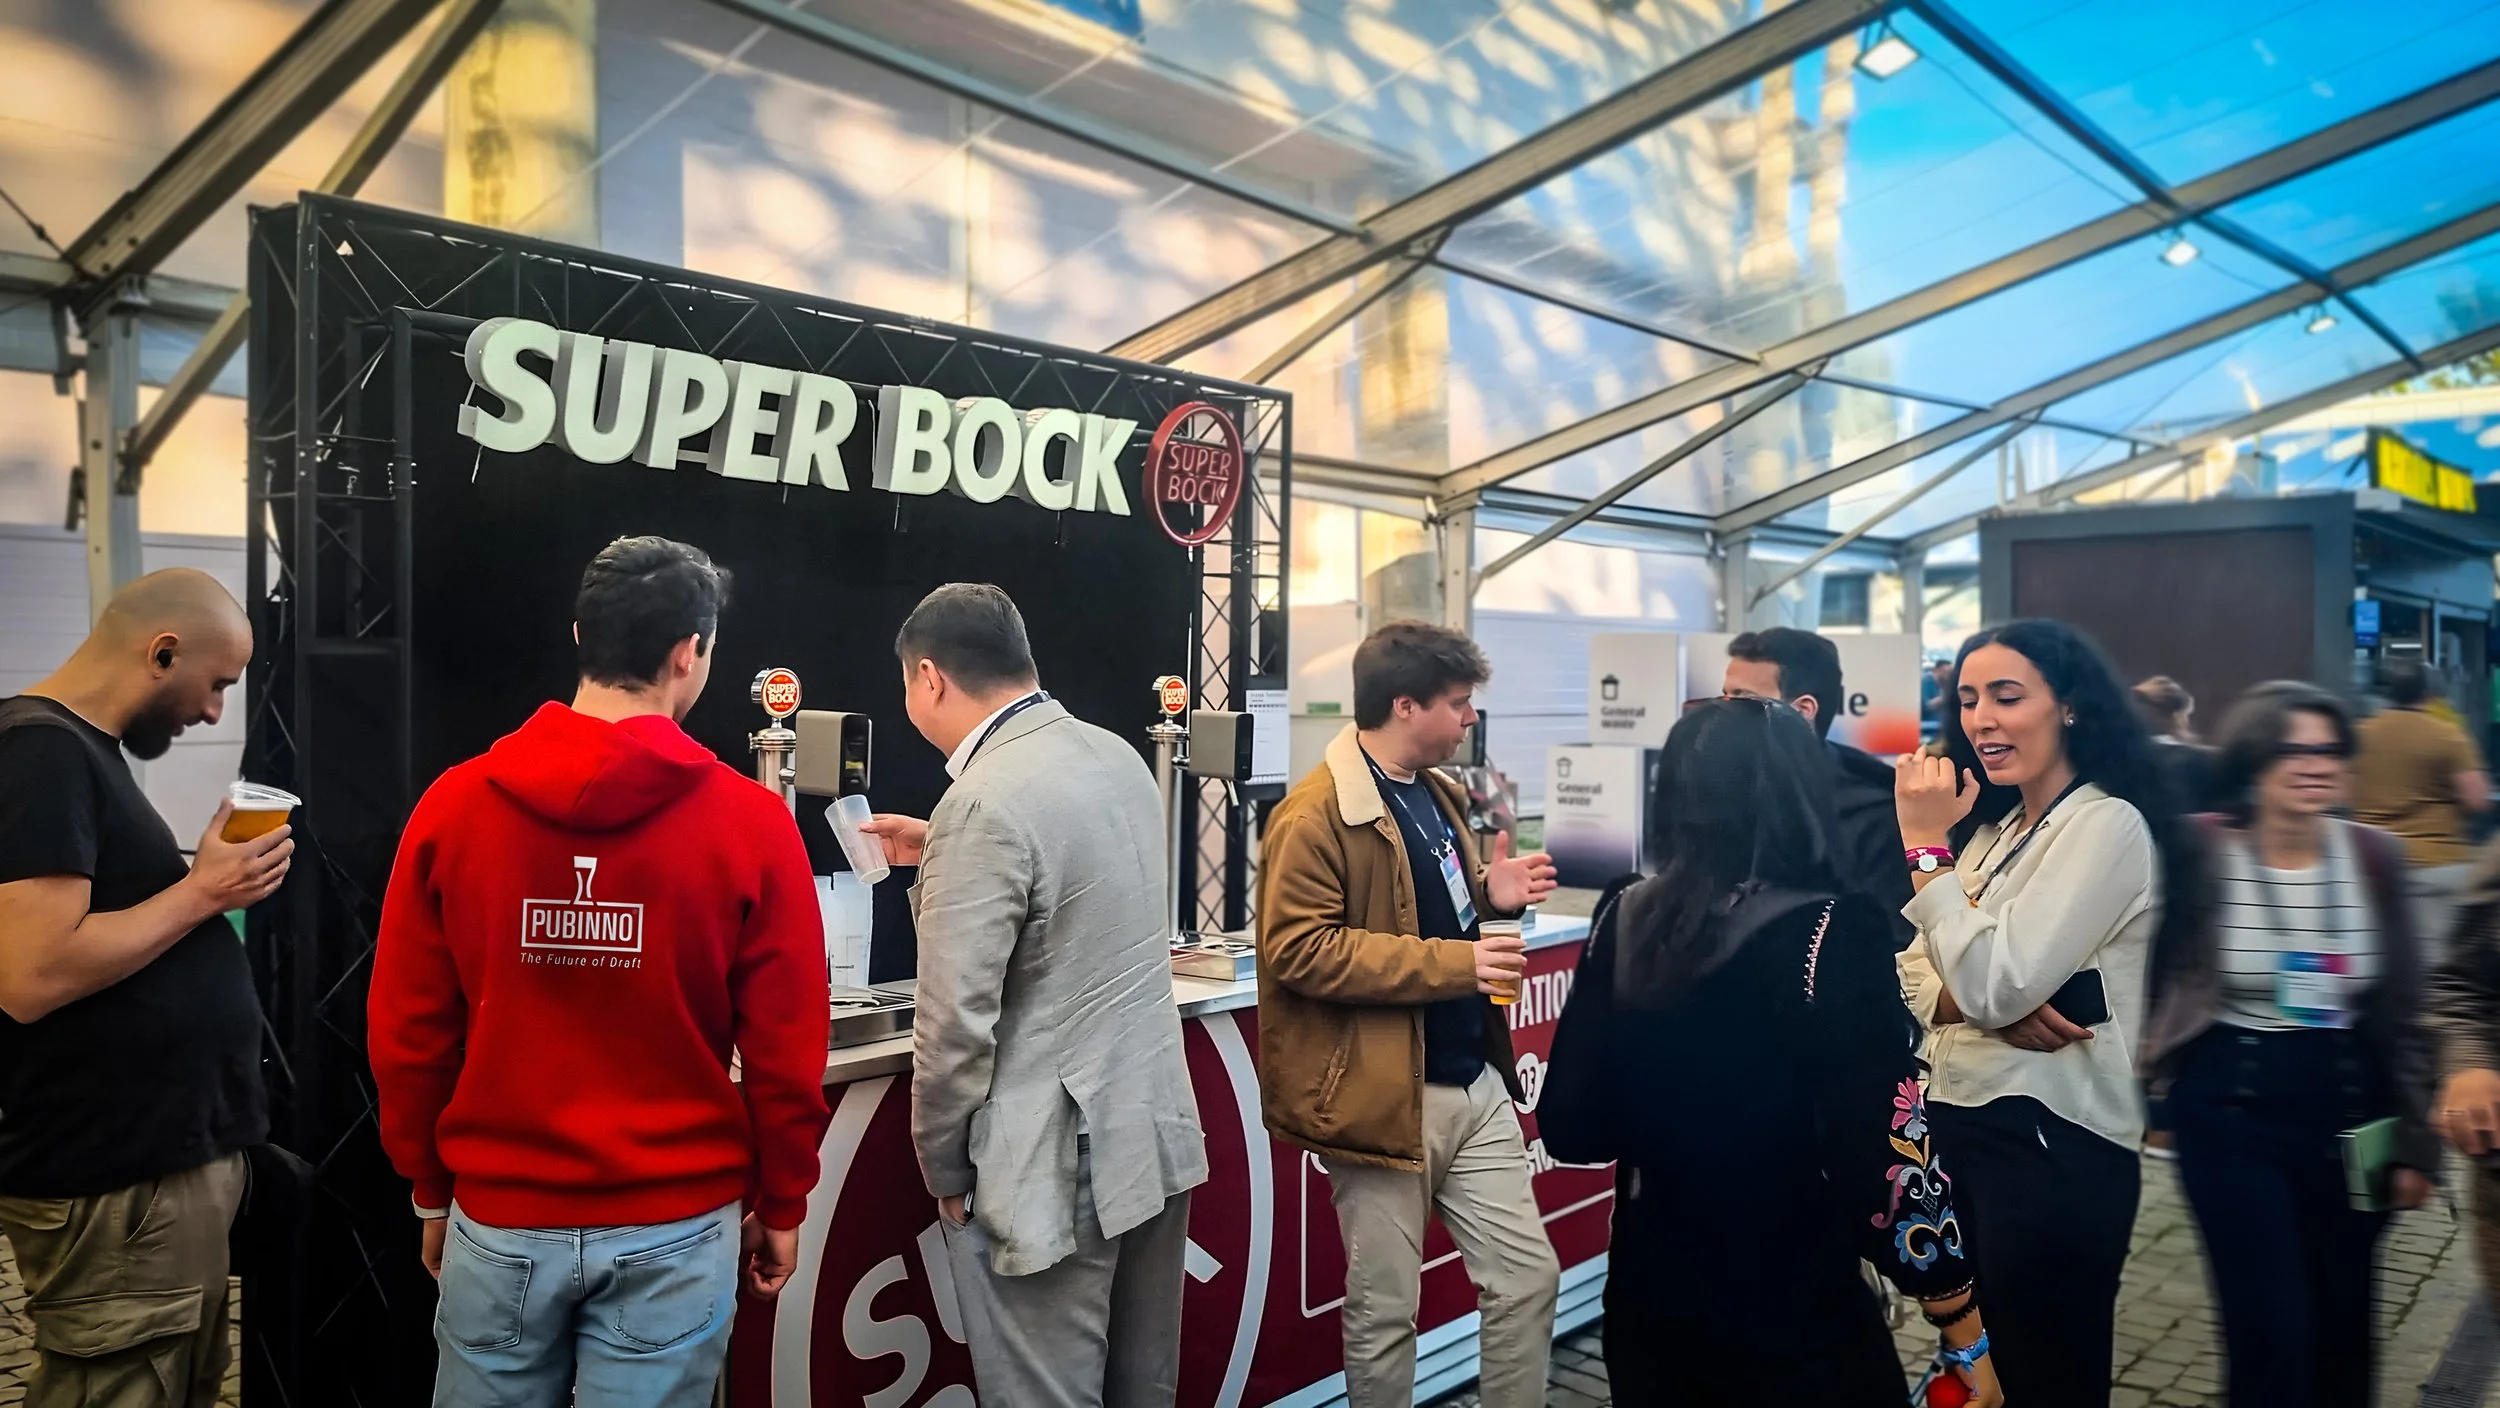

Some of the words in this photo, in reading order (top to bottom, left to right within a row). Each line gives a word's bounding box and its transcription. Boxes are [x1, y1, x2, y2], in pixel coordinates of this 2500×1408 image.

[458, 317, 857, 492] SUPER
[873, 384, 1140, 516] BOCK
[1167, 445, 1233, 477] SUPER
[1167, 475, 1228, 504] BOCK
[767, 683, 797, 694] SUPER
[768, 693, 795, 704] BOCK
[1601, 705, 1646, 718] General
[1556, 782, 1602, 795] General
[531, 908, 633, 942] PUBINNO
[520, 952, 542, 964] The
[547, 953, 587, 967] Future
[592, 956, 606, 968] of
[610, 956, 641, 969] Draft
